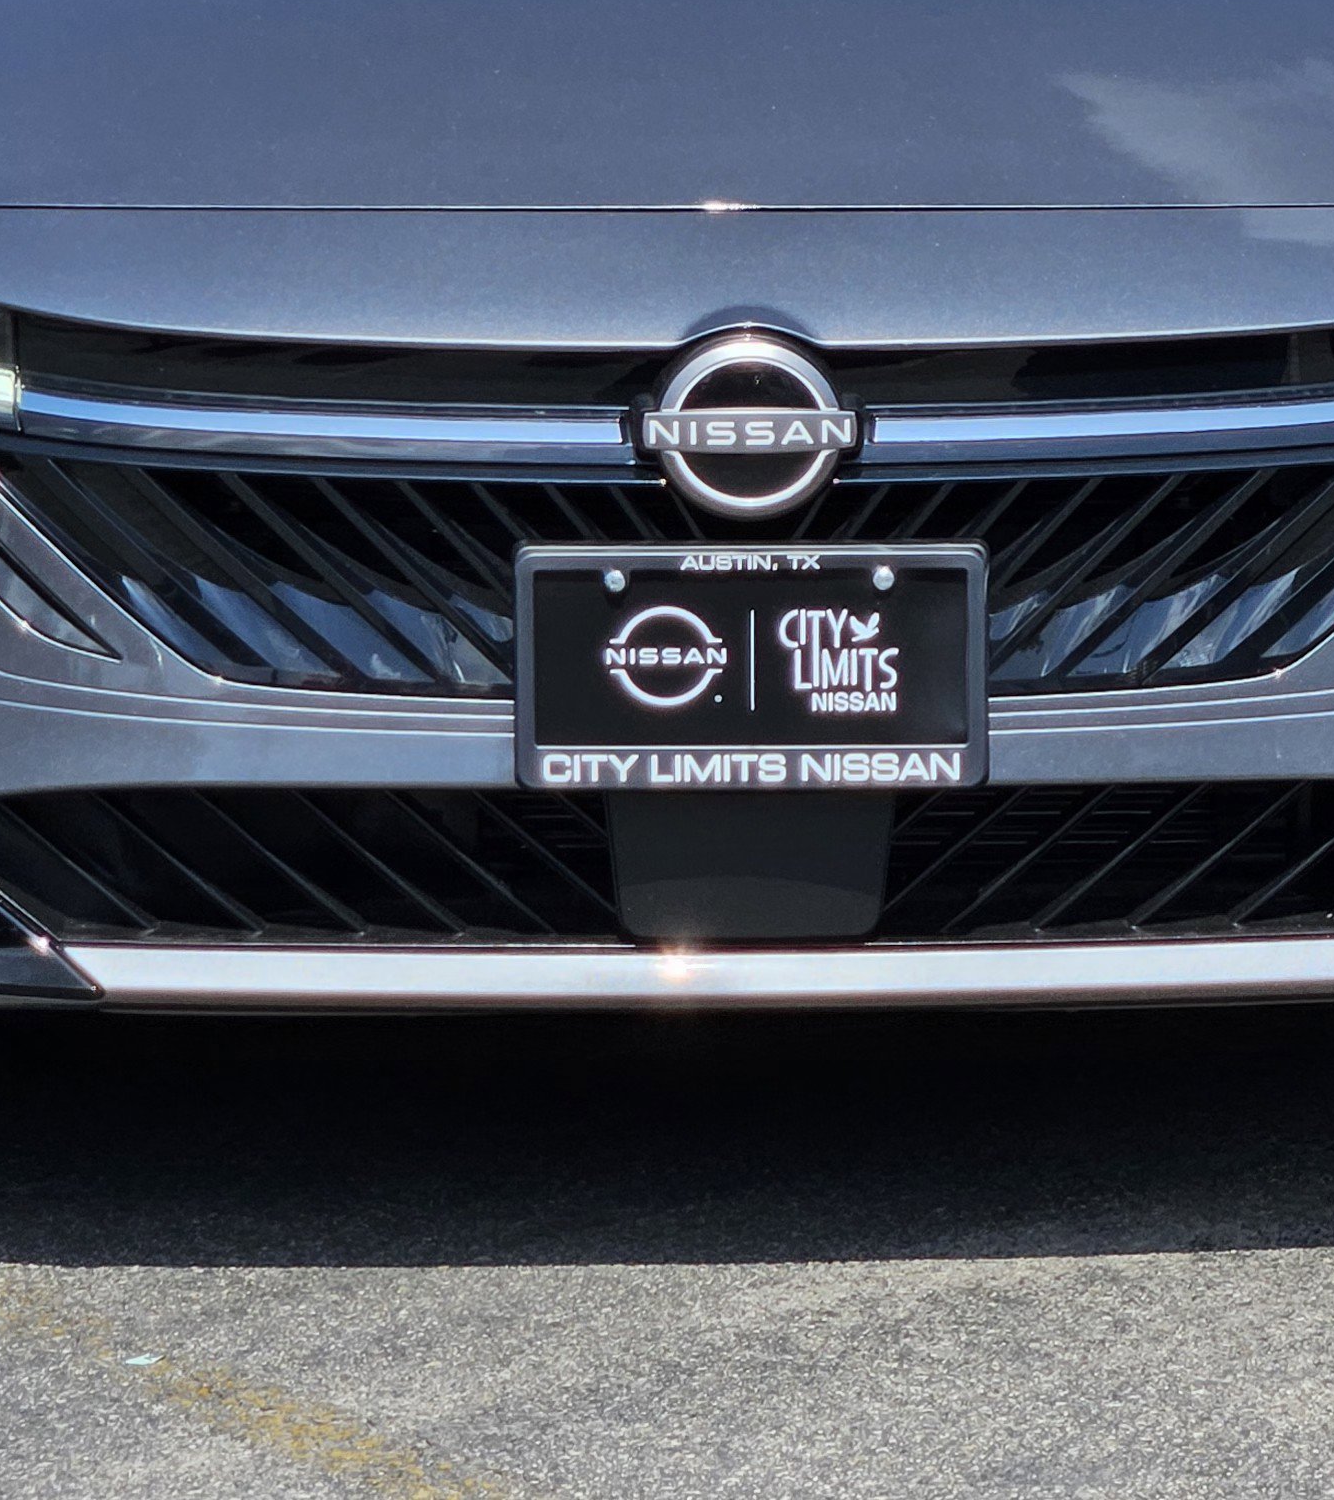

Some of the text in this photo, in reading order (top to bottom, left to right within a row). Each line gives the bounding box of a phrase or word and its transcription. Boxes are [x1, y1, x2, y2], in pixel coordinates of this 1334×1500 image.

[648, 418, 852, 446] NISSAN
[680, 554, 821, 571] AUSTIN, TX
[778, 608, 849, 650] CITY
[604, 646, 728, 665] NISSAN
[792, 646, 900, 692] LIMITS
[810, 691, 897, 712] NISSAN
[542, 752, 962, 783] CITY LIMITS NISSAN
